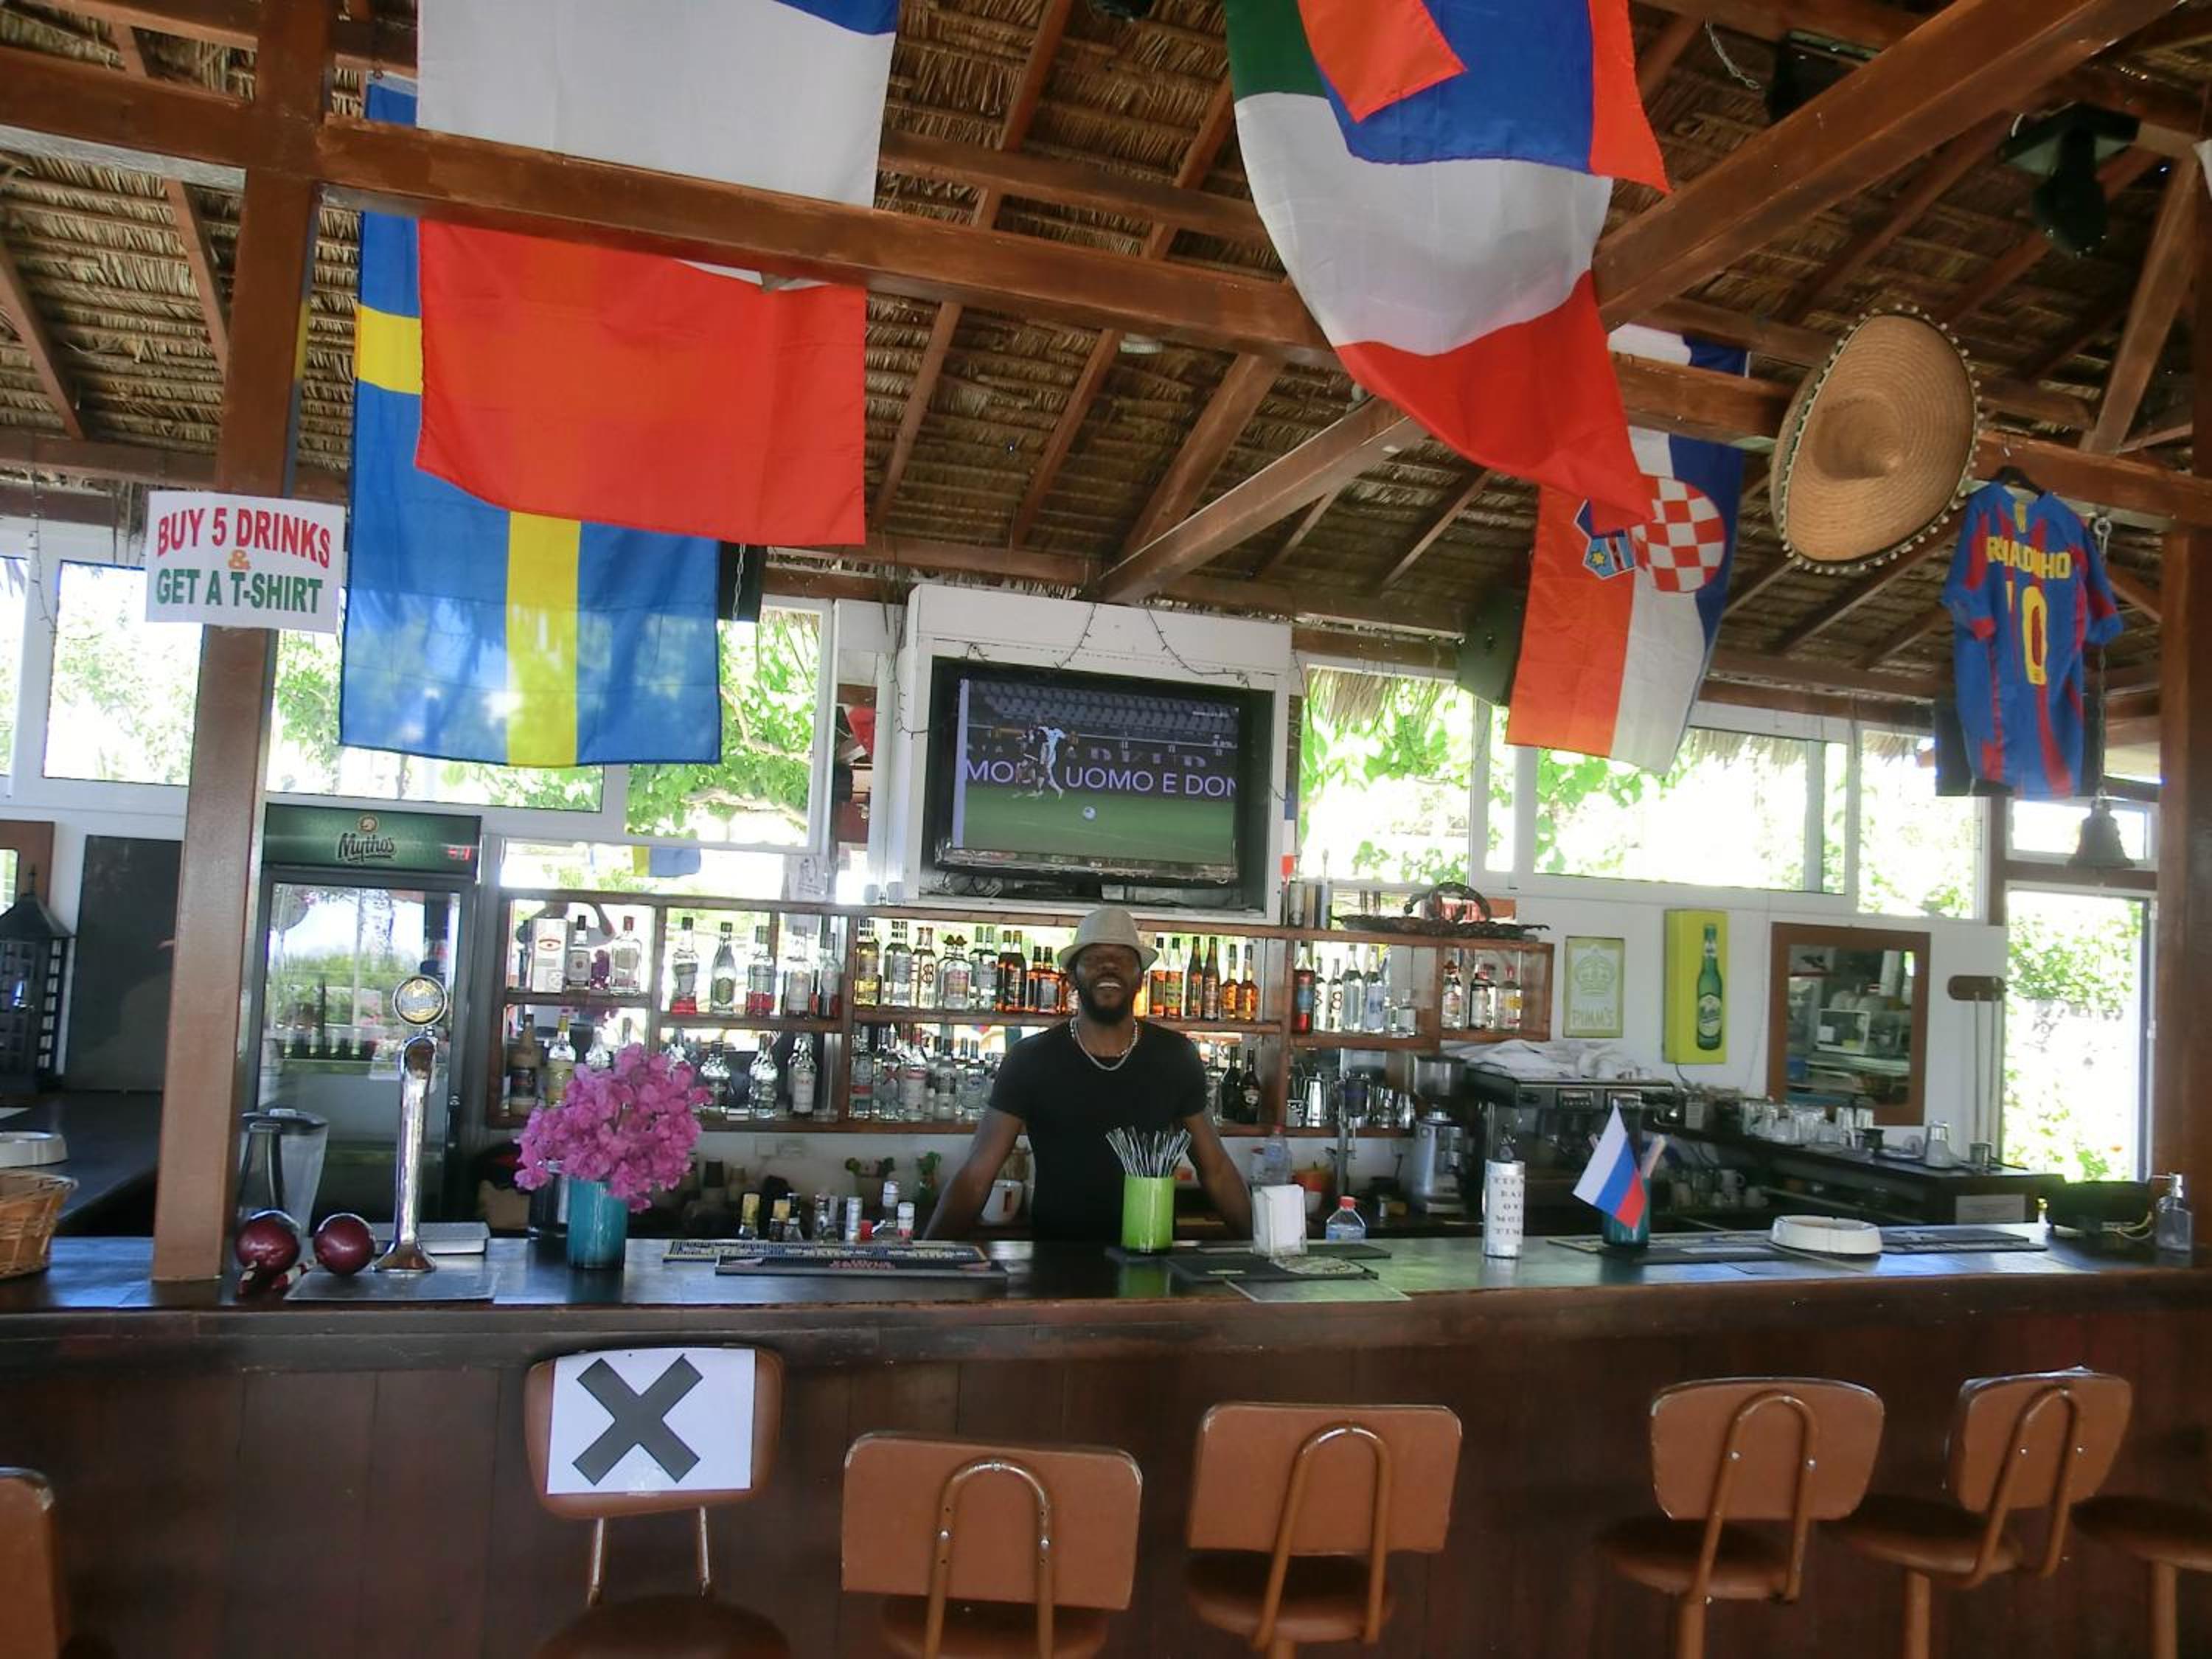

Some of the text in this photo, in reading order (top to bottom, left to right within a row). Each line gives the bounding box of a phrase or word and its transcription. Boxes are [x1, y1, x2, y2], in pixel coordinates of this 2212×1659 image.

[157, 507, 330, 568] BUY 5 DRINKS
[228, 549, 251, 571] &
[156, 568, 322, 613] GET A T-SHIRT
[1065, 766, 1154, 793] UOMO
[1162, 773, 1178, 793] E
[338, 832, 395, 861] Mythos
